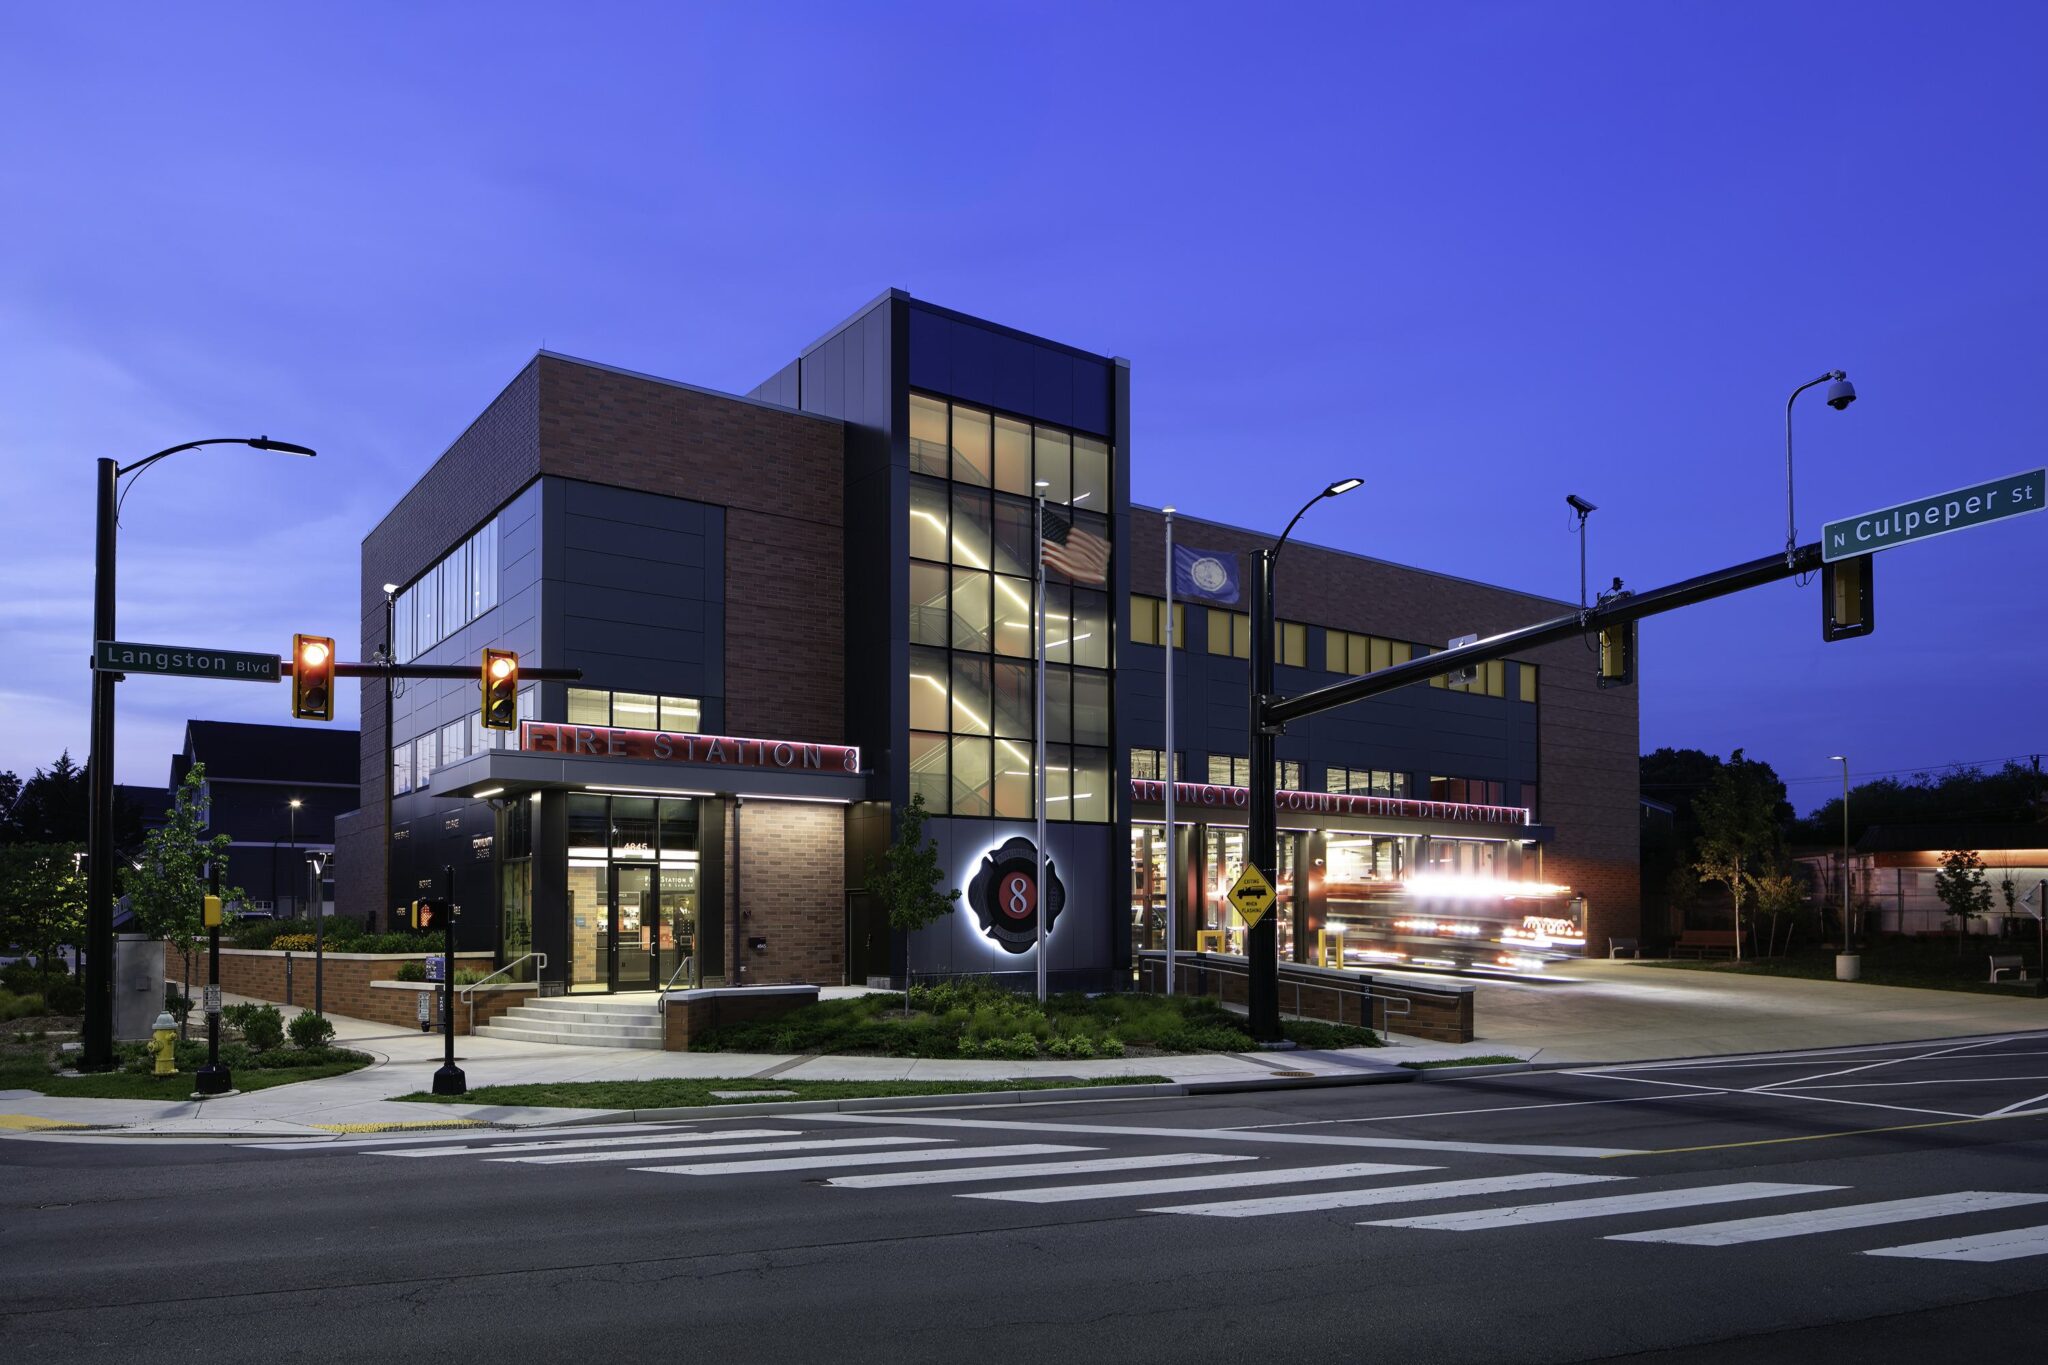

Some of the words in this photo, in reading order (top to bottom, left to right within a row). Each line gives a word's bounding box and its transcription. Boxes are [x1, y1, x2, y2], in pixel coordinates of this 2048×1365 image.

[1834, 533, 1845, 548] N
[1855, 490, 1997, 542] Culpeper
[2011, 485, 2033, 503] St
[108, 647, 226, 670] Langston
[236, 661, 270, 673] Blvd
[526, 723, 628, 756] FIRE
[653, 733, 821, 769] STATION
[843, 748, 858, 771] 8
[1275, 791, 1356, 814] COUNTY
[1367, 798, 1409, 817] FIRE
[1418, 802, 1528, 825] DEPARTMENT
[1009, 878, 1028, 913] 8
